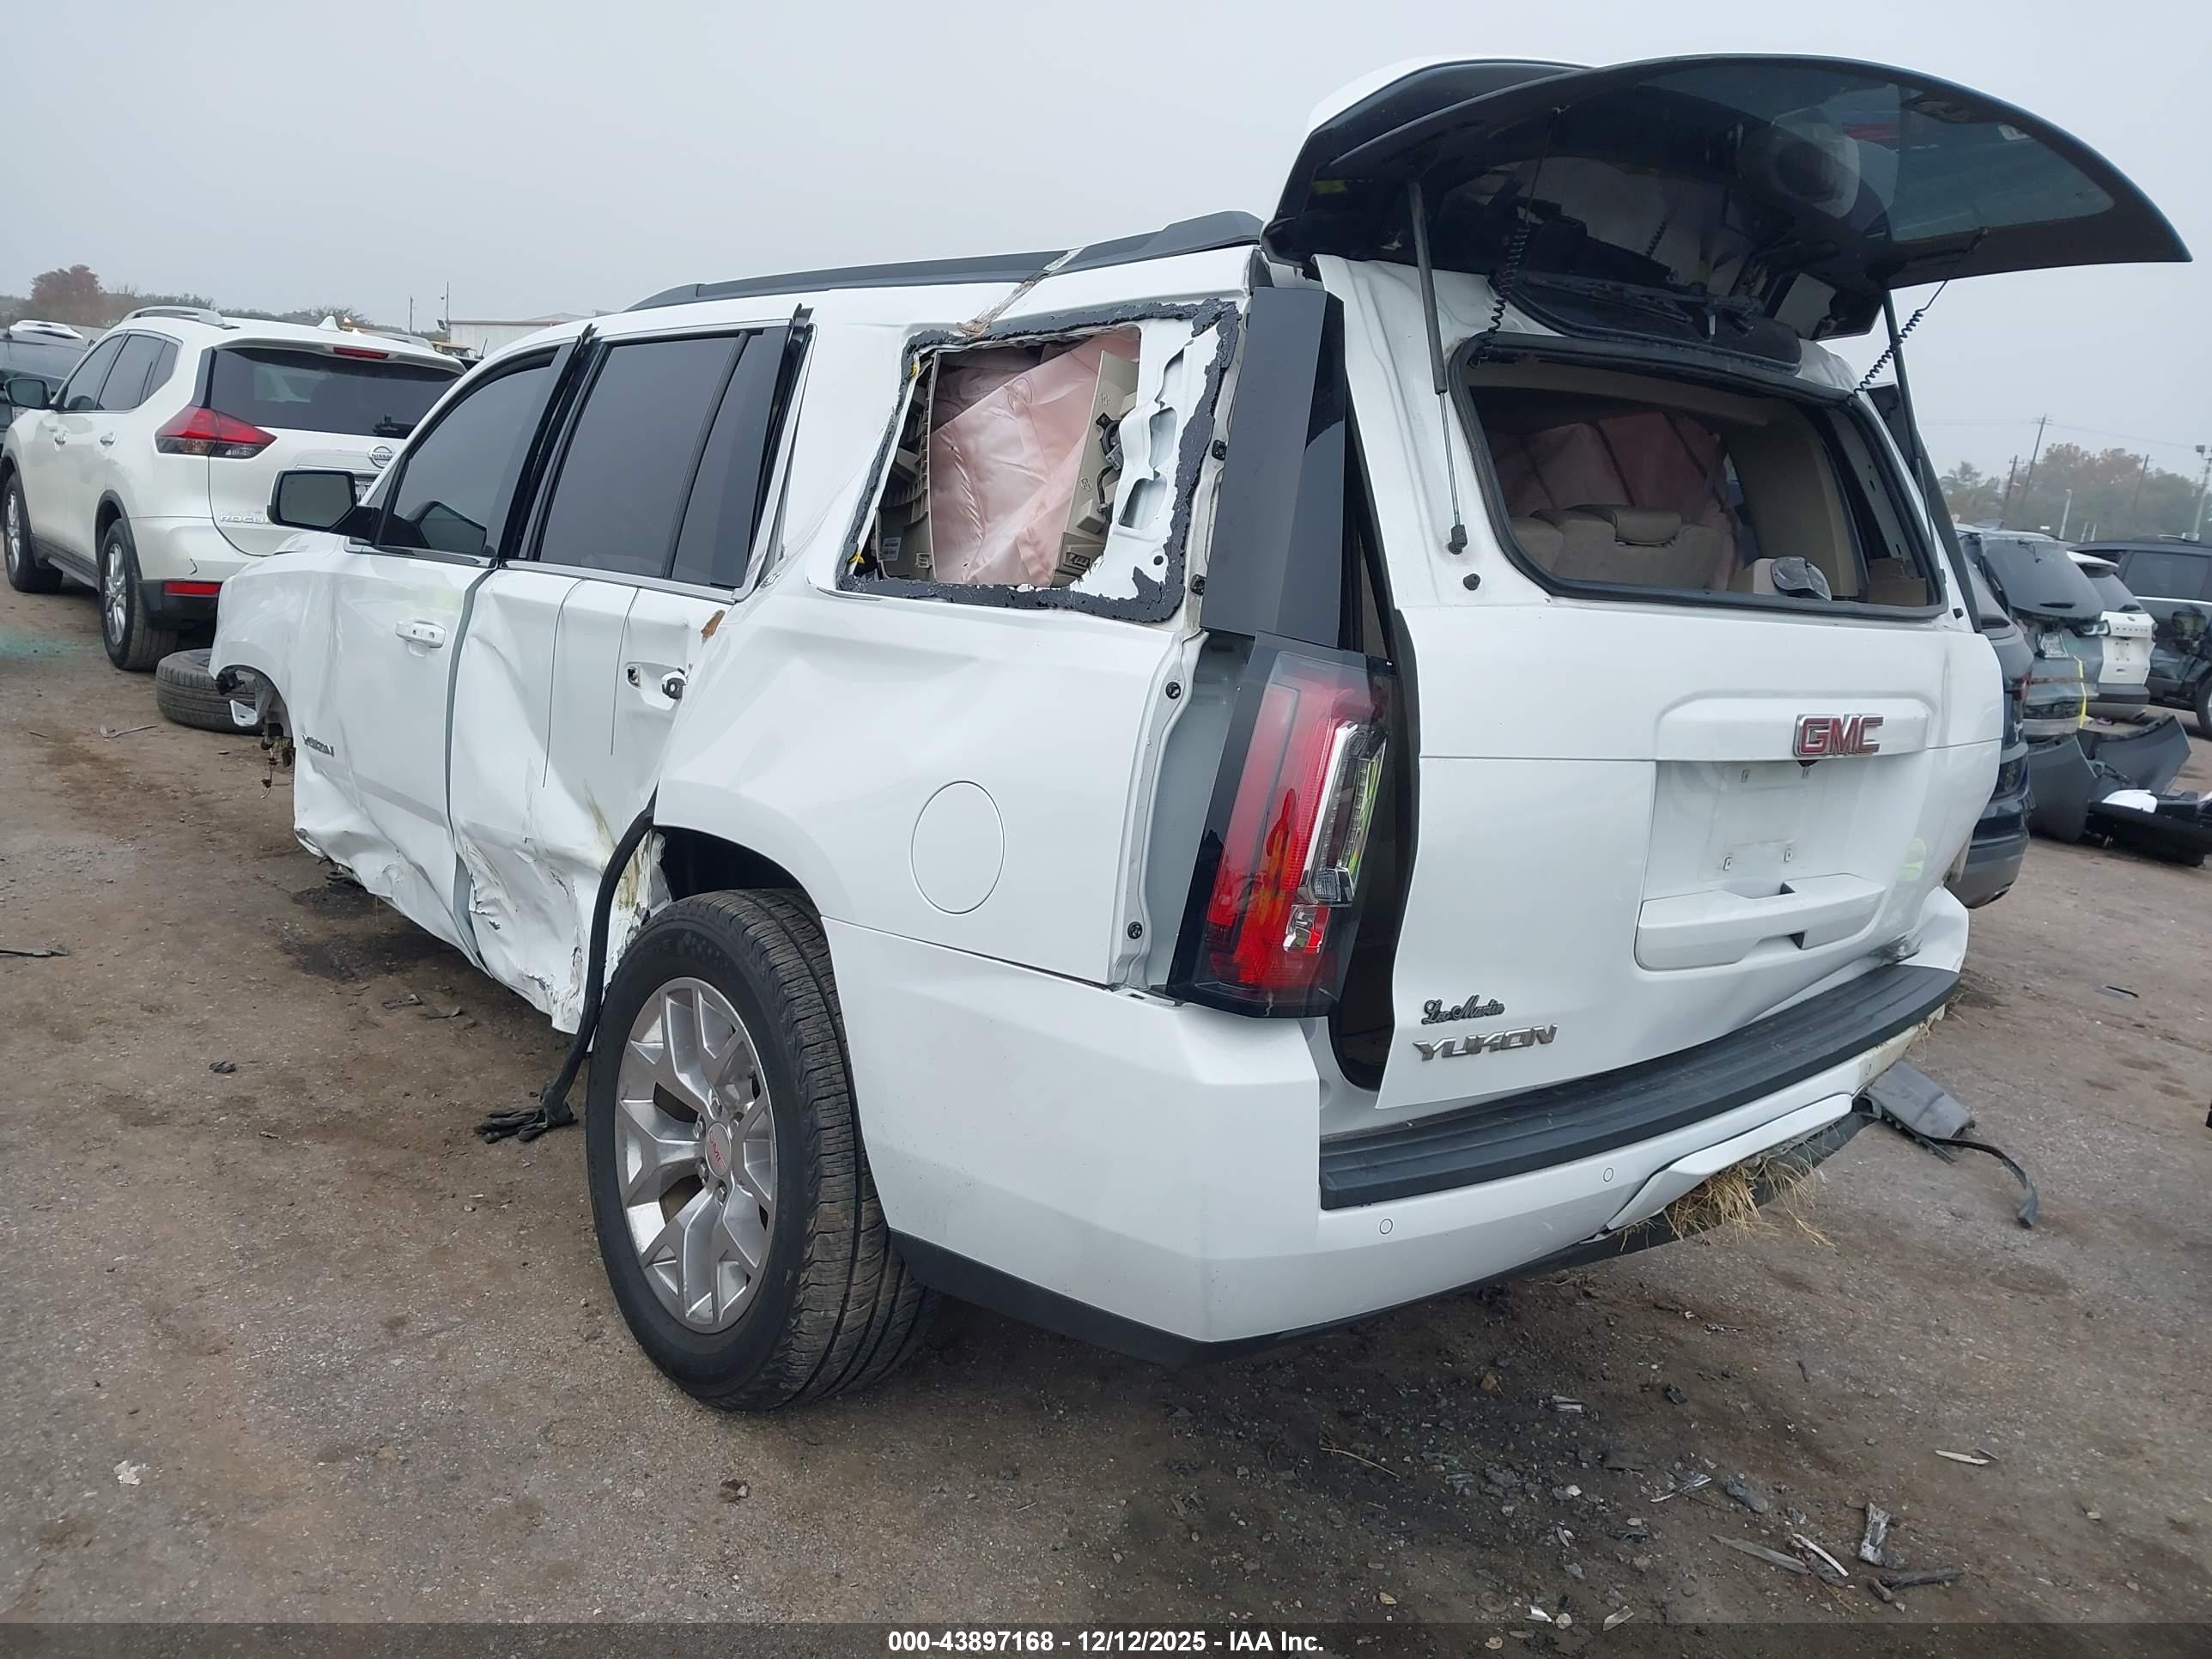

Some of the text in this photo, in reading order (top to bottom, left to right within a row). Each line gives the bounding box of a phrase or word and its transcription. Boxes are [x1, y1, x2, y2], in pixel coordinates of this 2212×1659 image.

[1793, 714, 1884, 757] GMC
[1450, 994, 1505, 1020] Martin
[1413, 1024, 1558, 1061] YUKON
